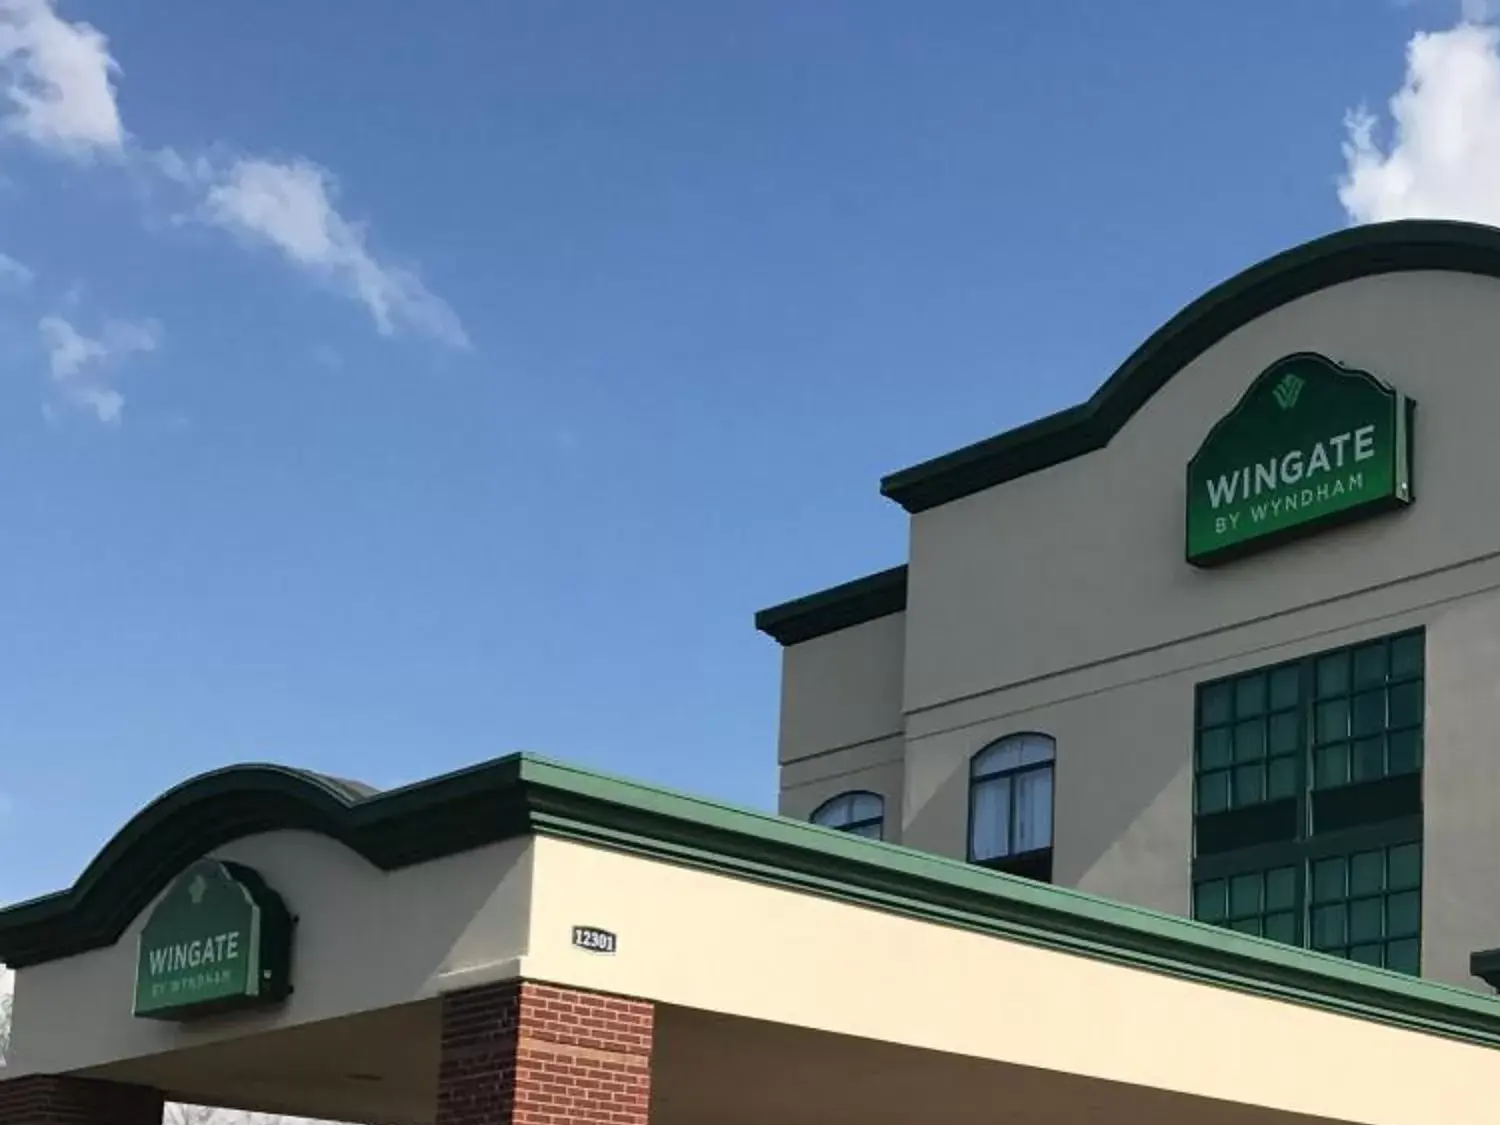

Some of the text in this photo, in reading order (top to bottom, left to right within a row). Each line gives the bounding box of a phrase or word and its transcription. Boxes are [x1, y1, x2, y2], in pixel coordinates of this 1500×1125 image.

[1206, 424, 1375, 509] WINGATE
[1215, 472, 1364, 534] BY WYNDHAM
[149, 931, 239, 977] WINGATE
